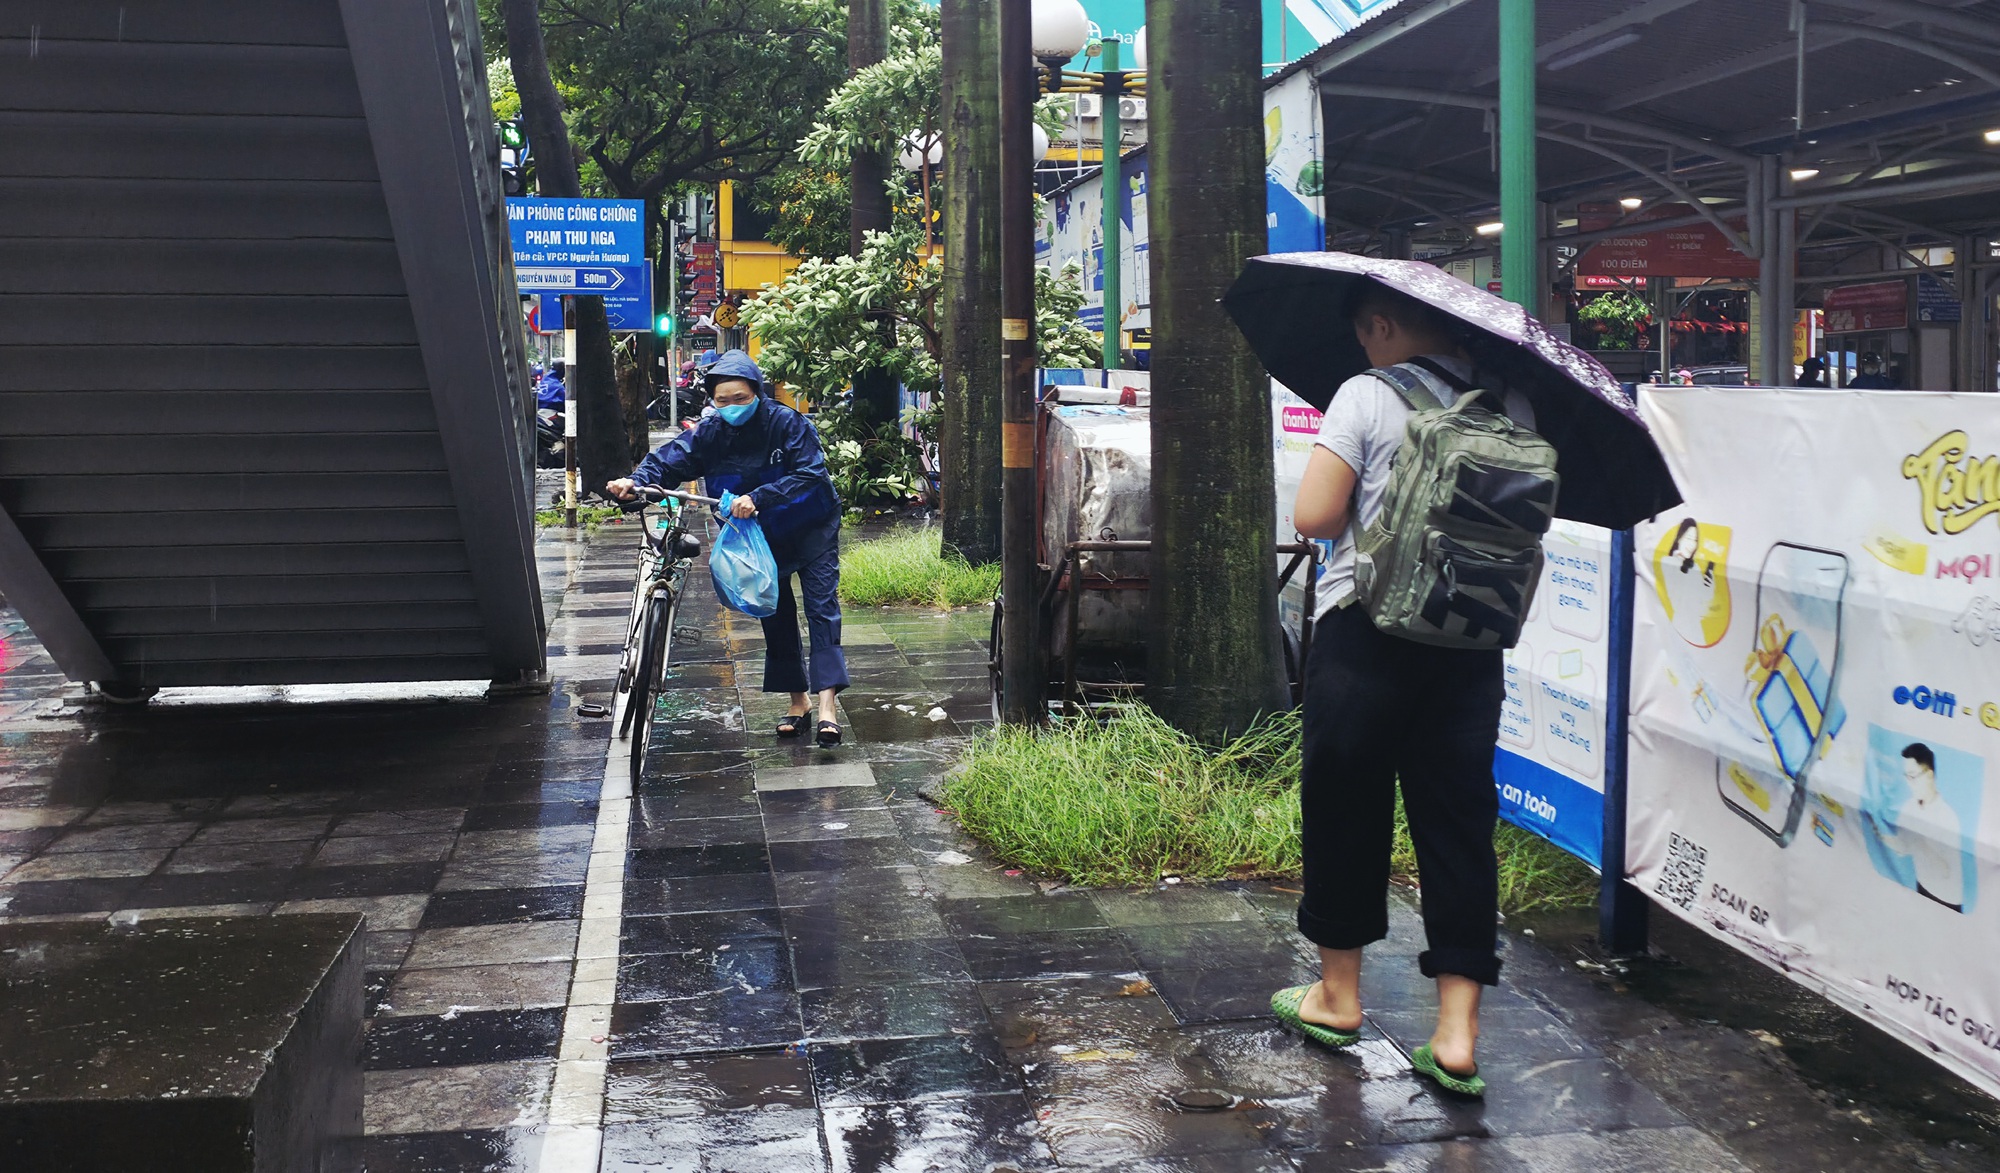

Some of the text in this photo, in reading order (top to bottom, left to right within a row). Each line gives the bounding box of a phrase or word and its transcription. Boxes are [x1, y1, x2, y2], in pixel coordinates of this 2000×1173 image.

[527, 204, 565, 221] PHÒNG
[567, 204, 597, 221] CÔNG
[600, 204, 637, 222] CHỨNG
[525, 230, 616, 248] PHẠM THU NGA
[513, 252, 530, 262] (Tên
[546, 253, 568, 262] VPCC
[570, 251, 600, 263] Nguyễn
[601, 253, 630, 264] Hương)
[1601, 256, 1648, 269] 100 ĐIỂM
[559, 274, 572, 284] LỘC
[584, 273, 607, 284] 500m
[1283, 410, 1308, 430] thanh
[1935, 553, 1993, 585] MỌI
[1541, 681, 1568, 704] Thanh
[1892, 684, 1956, 719] eGift
[1560, 709, 1576, 728] vay
[1502, 784, 1522, 805] an
[1524, 790, 1557, 823] toàn
[1710, 883, 1747, 915] SCAN
[1885, 974, 1920, 1004] HỢP
[1924, 994, 1957, 1026] TÁC
